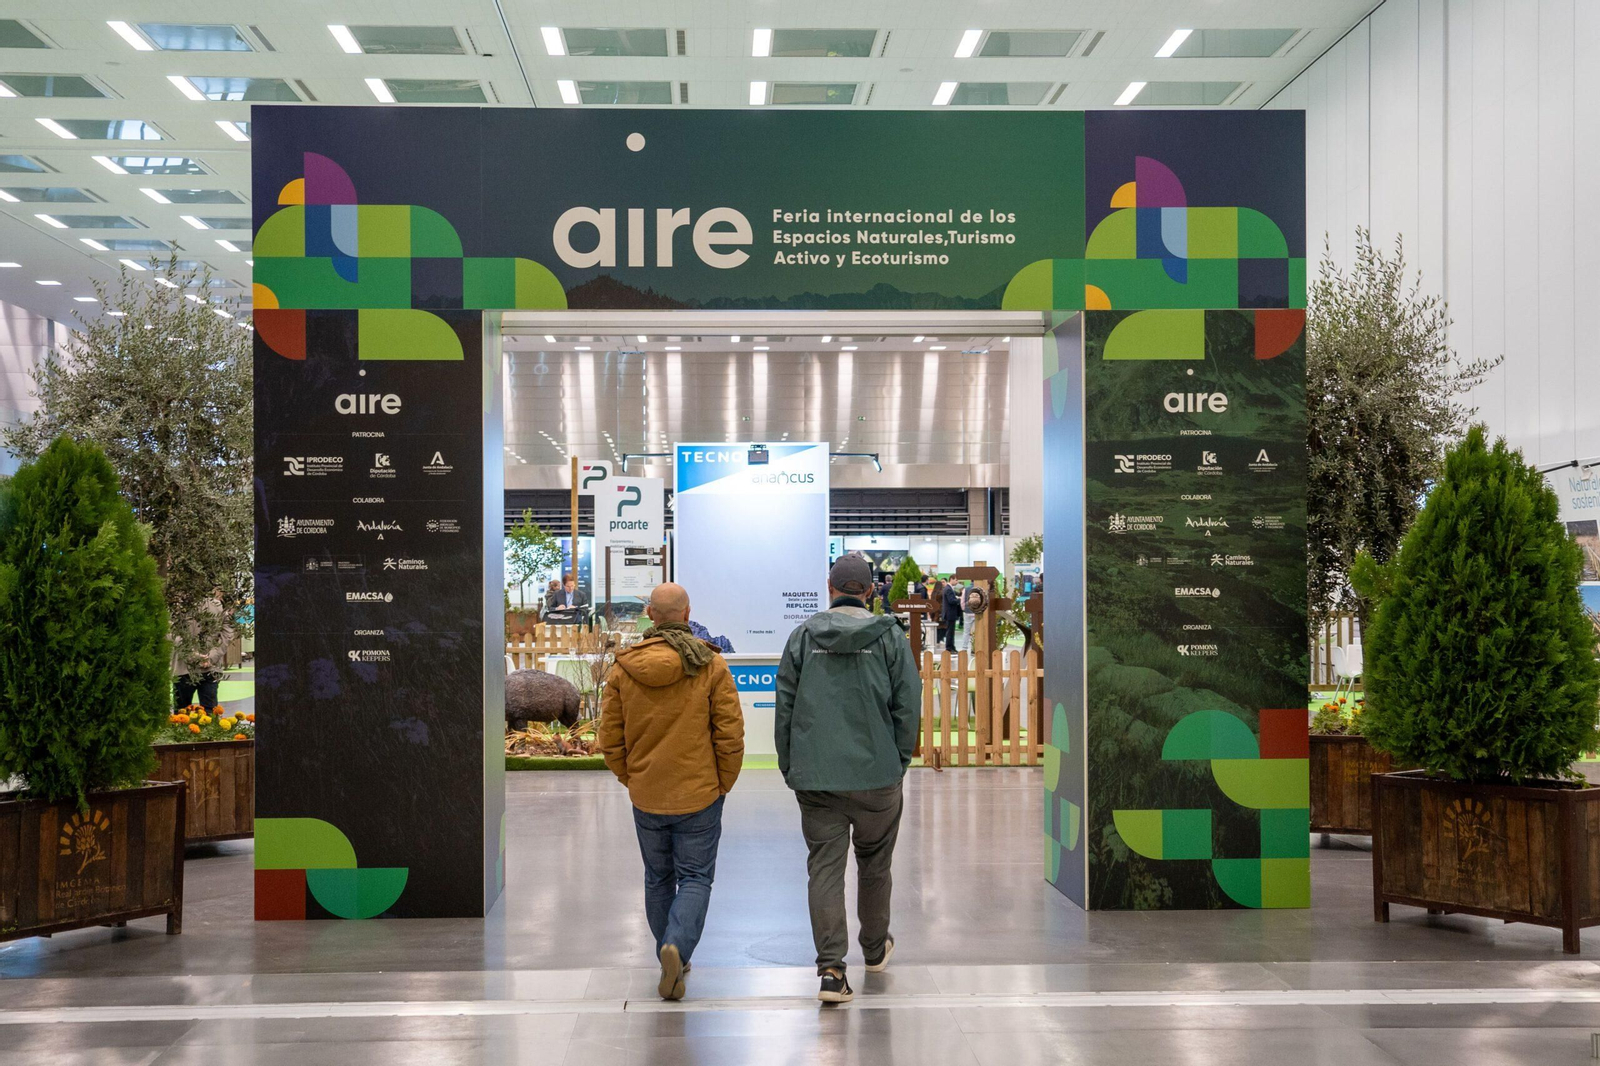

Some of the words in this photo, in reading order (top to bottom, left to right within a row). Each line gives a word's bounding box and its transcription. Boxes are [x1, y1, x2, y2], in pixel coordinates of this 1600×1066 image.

[773, 209, 820, 223] Feria
[827, 209, 952, 223] internacional
[960, 210, 982, 223] de
[990, 209, 1016, 223] los
[773, 230, 850, 247] Espacios
[774, 251, 830, 264] Activo
[836, 254, 846, 268] y
[852, 251, 949, 264] Ecoturismo
[1568, 474, 1600, 492] Natural
[356, 520, 404, 532] Andalucía
[609, 519, 648, 532] proarte
[1185, 517, 1230, 528] Andalucía
[732, 674, 776, 685] CNO
